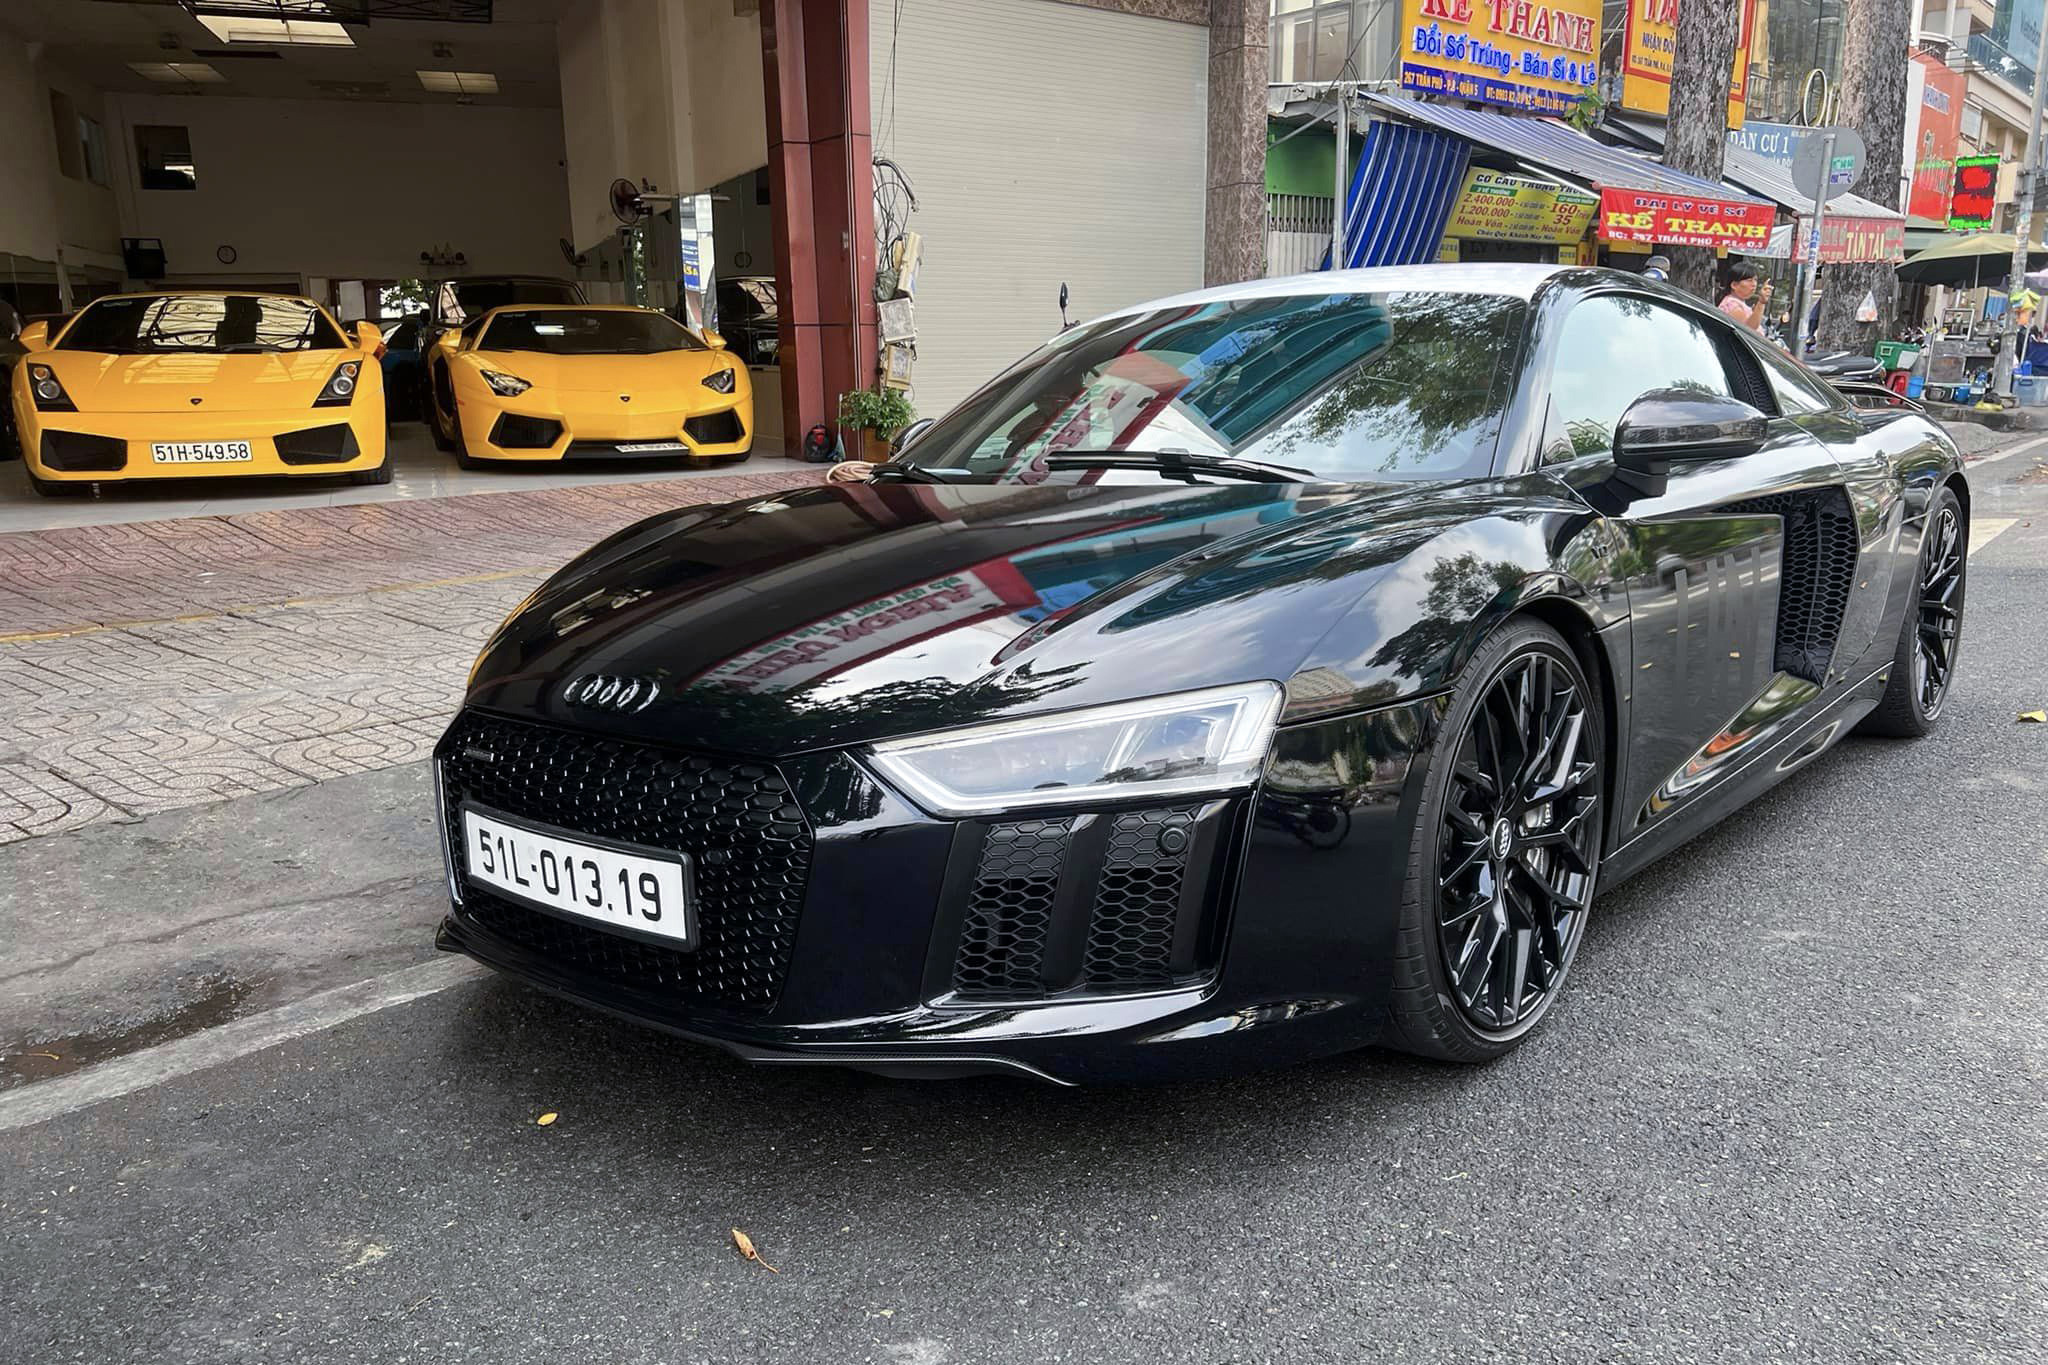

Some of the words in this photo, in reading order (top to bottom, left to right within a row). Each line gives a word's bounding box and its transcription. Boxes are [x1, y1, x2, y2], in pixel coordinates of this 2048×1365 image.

[1487, 0, 1597, 54] THANH
[1445, 33, 1468, 60] Số
[1469, 40, 1512, 76] Trúng
[1521, 50, 1550, 77] Bán
[1567, 62, 1579, 83] &
[1760, 133, 1781, 153] CƯ
[1463, 192, 1515, 208] 2.400.000
[1551, 203, 1578, 215] 160
[1459, 204, 1511, 219] 1.200.000
[1553, 214, 1573, 226] 35
[1606, 210, 1656, 230] KẾ
[1665, 217, 1767, 239] THANH
[154, 443, 249, 462] 51H-549.58
[477, 827, 662, 922] 51L-013.19
